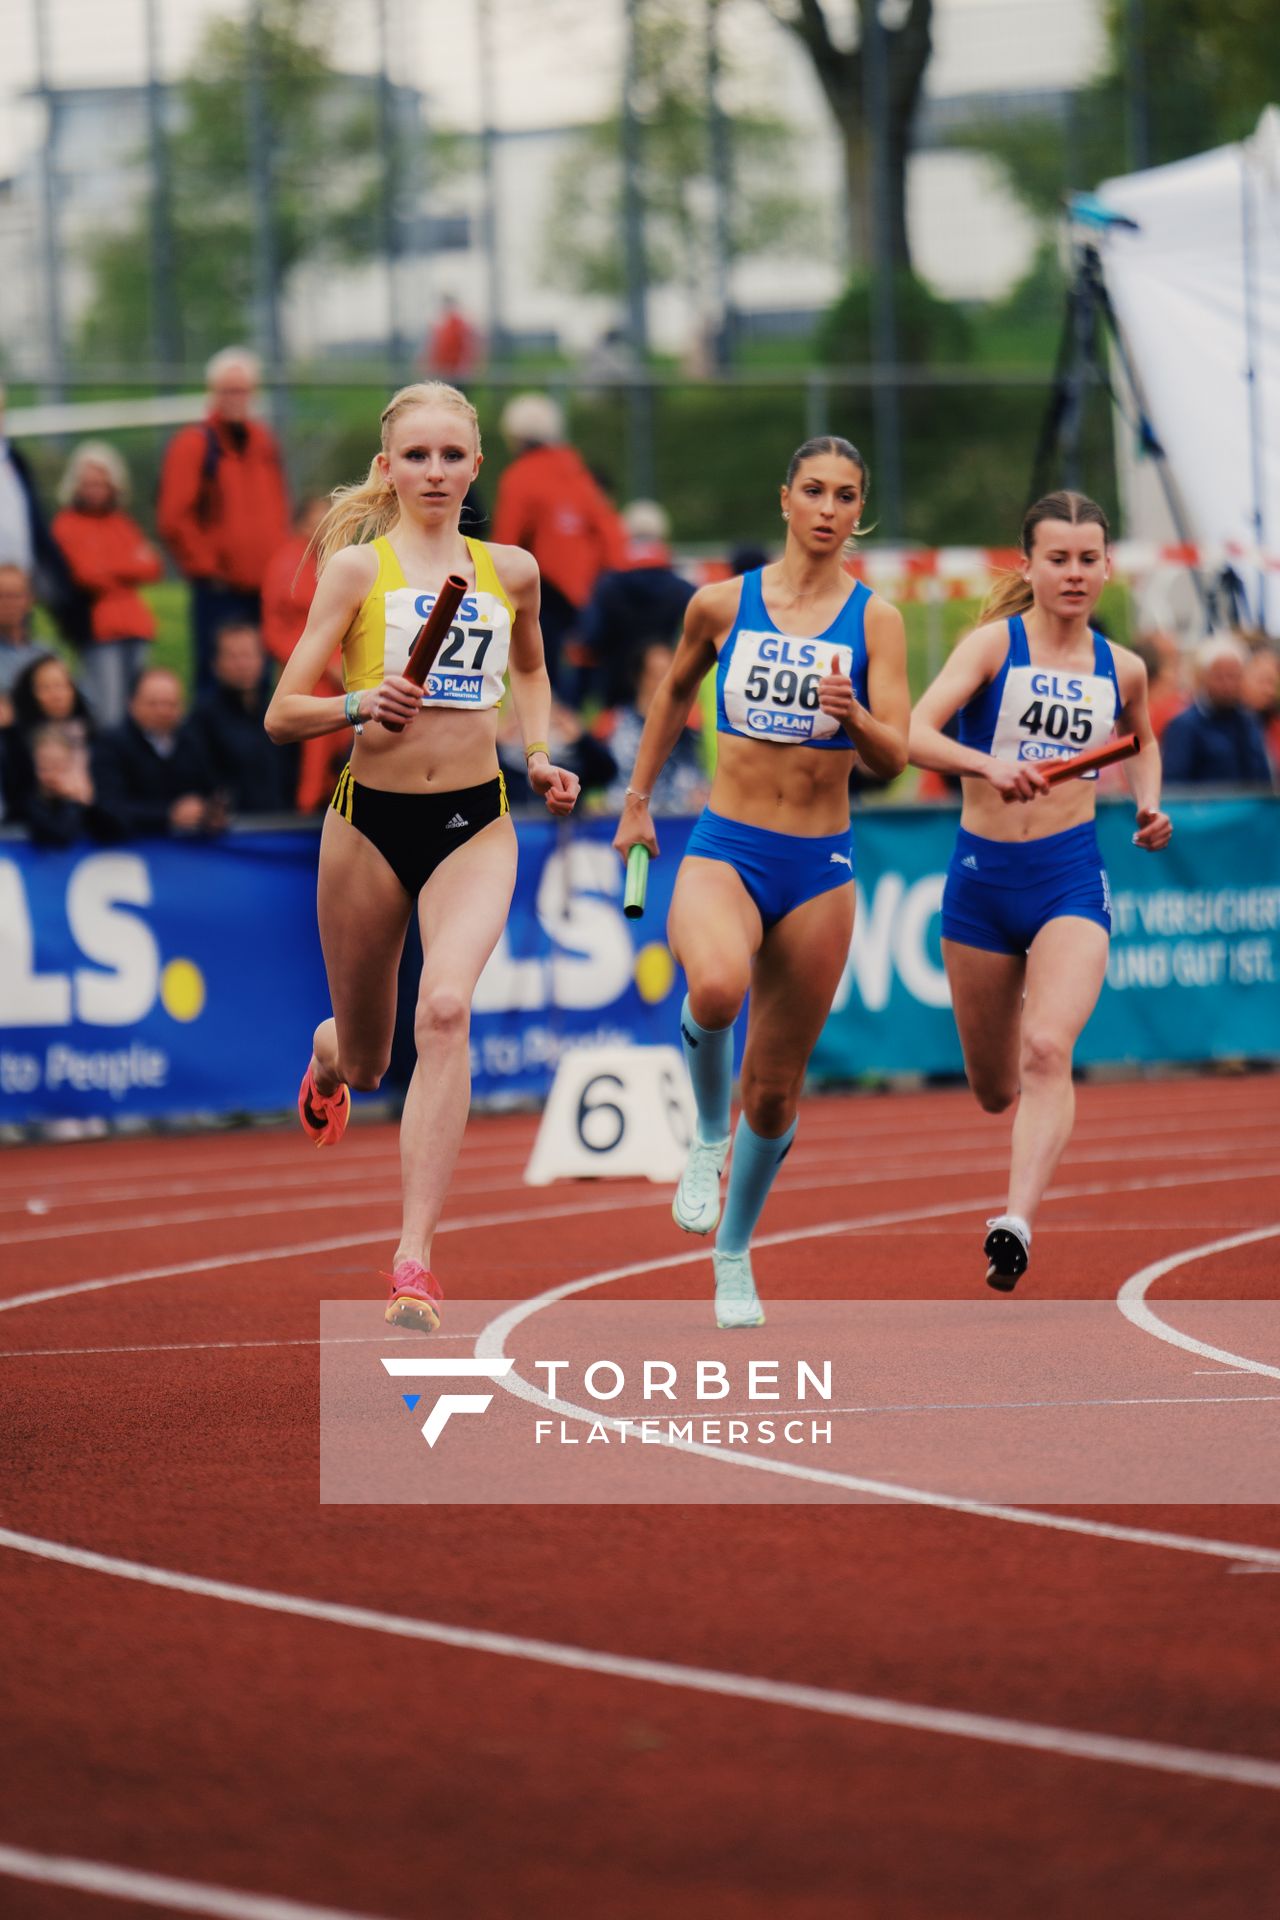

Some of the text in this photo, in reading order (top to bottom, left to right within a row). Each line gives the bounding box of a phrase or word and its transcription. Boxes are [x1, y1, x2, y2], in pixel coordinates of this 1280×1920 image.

[415, 595, 488, 622] GS.
[758, 638, 824, 669] GLS.
[444, 678, 480, 693] PLAN
[744, 665, 823, 711] 596
[1031, 674, 1092, 703] GLS.
[773, 715, 811, 730] PLAN
[1019, 701, 1093, 744] 405
[46, 1043, 167, 1099] People
[577, 1073, 625, 1153] 6
